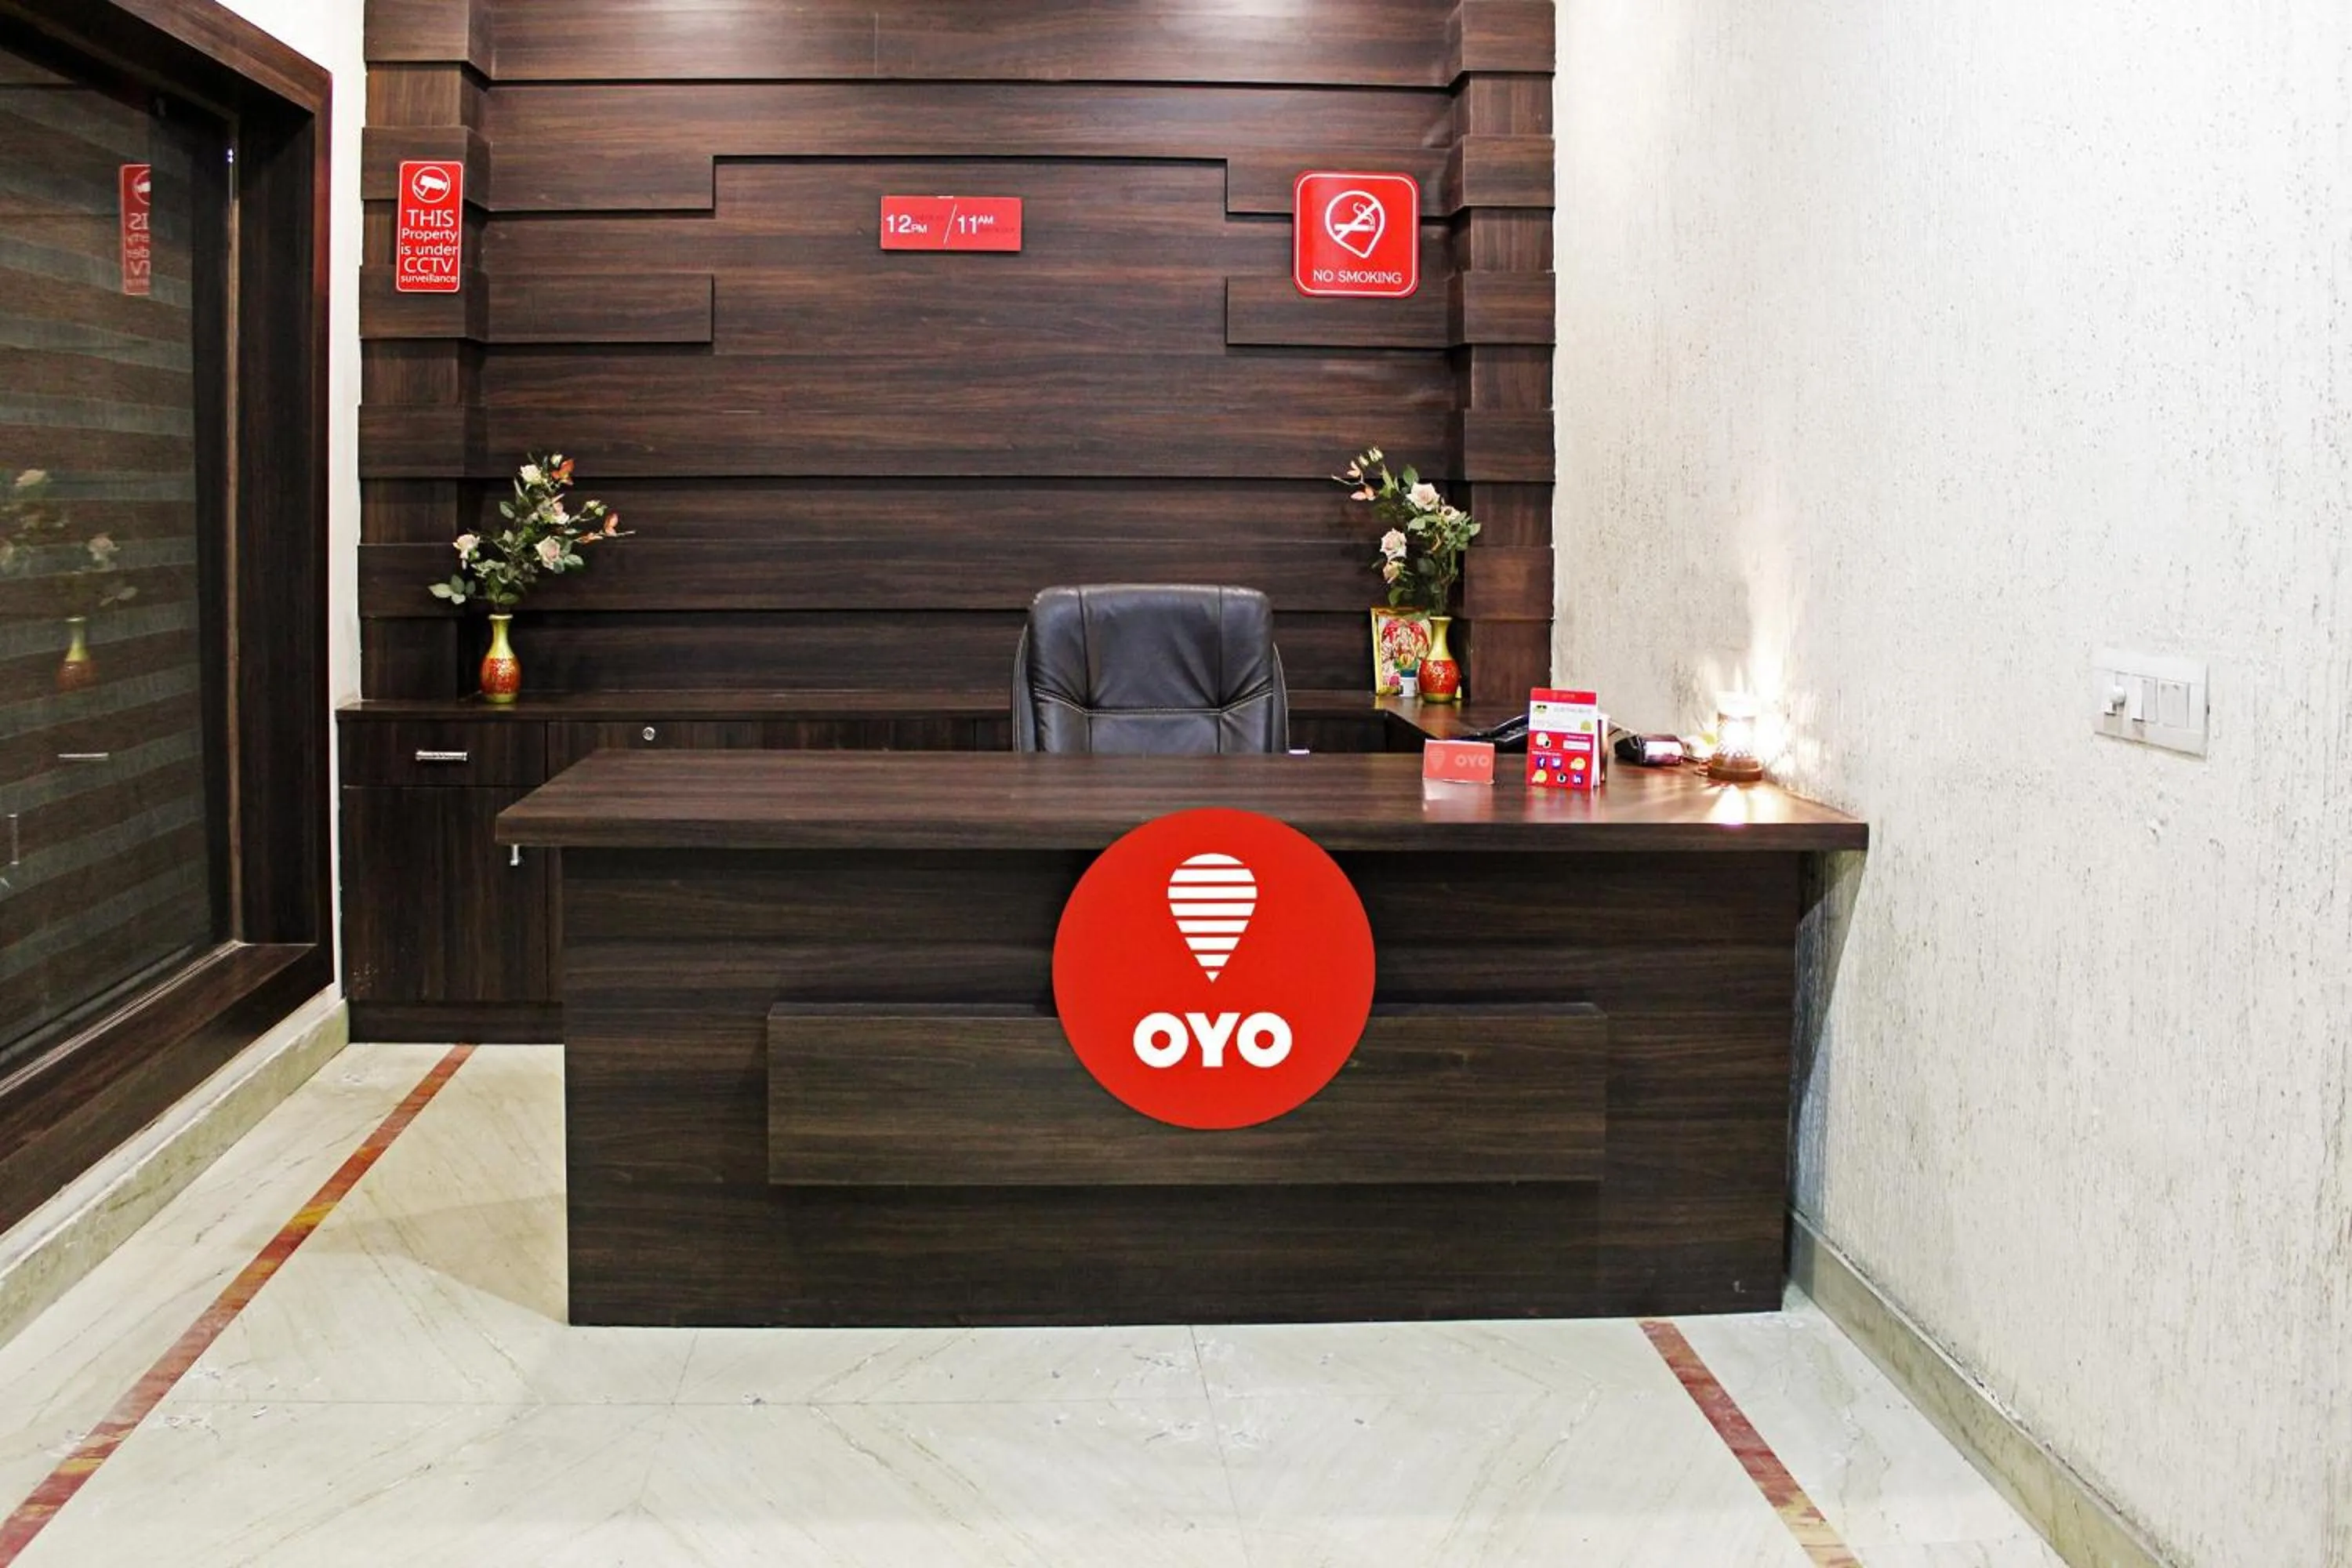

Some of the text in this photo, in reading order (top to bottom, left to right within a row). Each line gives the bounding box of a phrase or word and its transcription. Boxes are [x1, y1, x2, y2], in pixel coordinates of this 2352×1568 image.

[406, 209, 454, 227] THIS
[886, 214, 994, 234] 12PM 11AM
[401, 228, 457, 242] Property
[401, 242, 458, 256] is under
[404, 256, 454, 274] CCTV
[401, 274, 457, 283] surveillance
[1312, 269, 1403, 285] NO SMOKING
[1456, 754, 1490, 768] OYO
[1133, 1011, 1293, 1069] OYO
